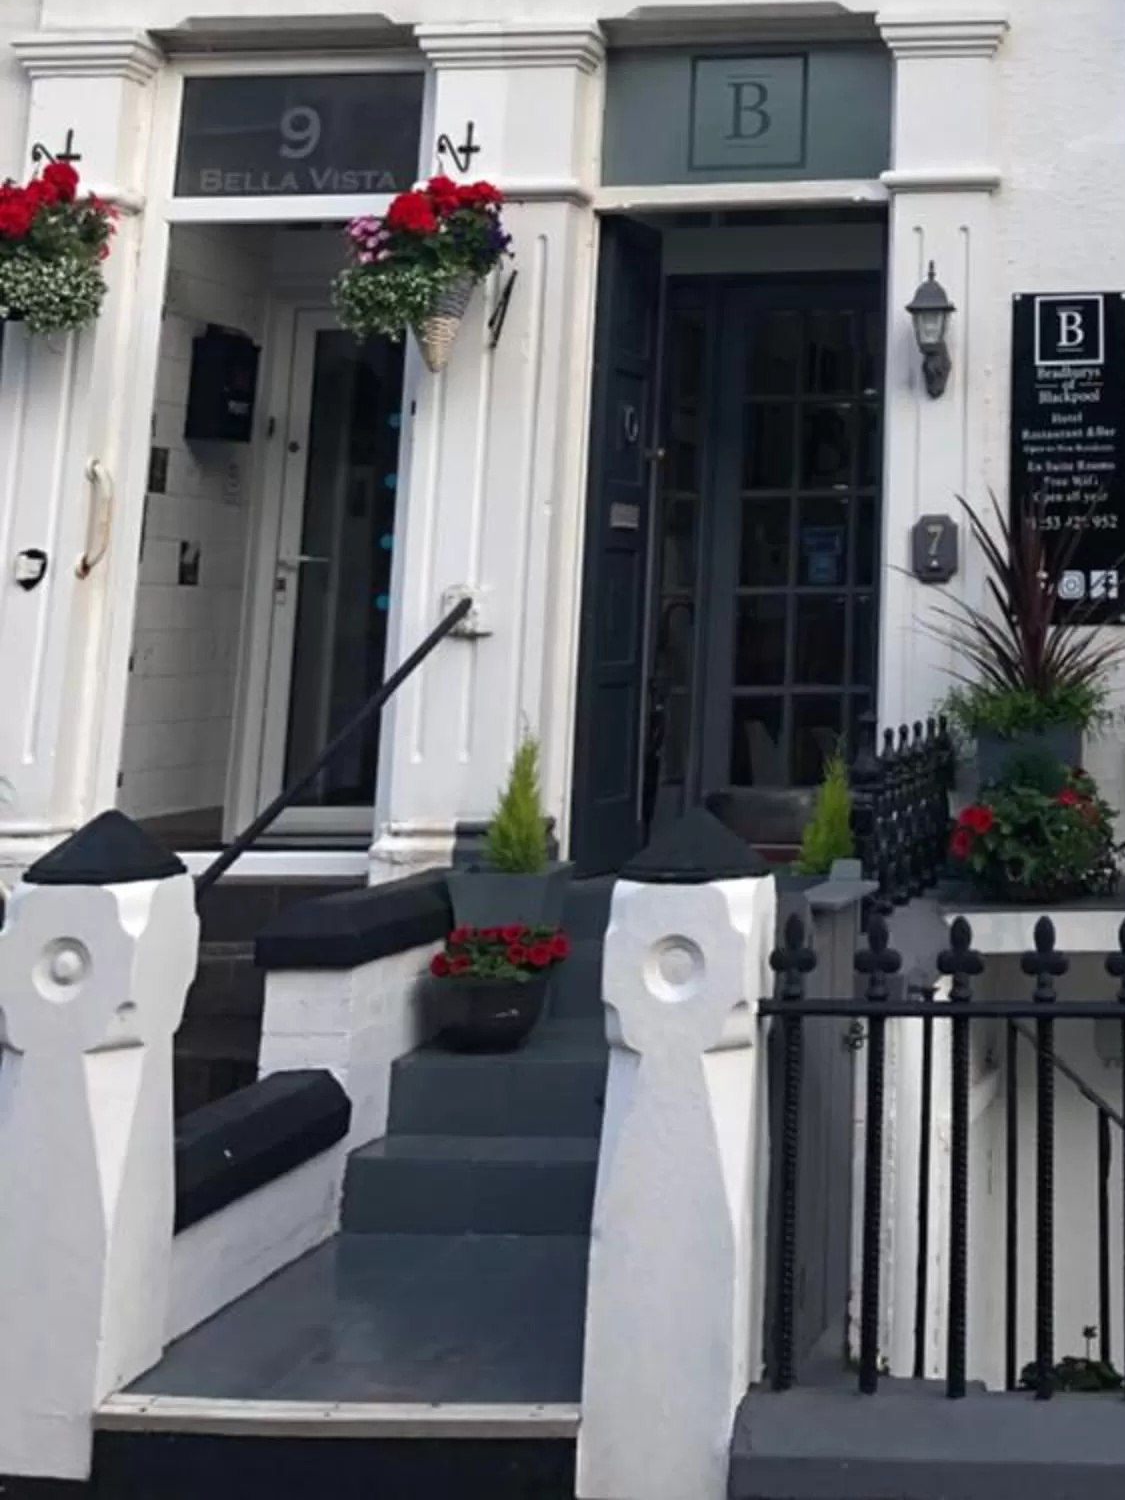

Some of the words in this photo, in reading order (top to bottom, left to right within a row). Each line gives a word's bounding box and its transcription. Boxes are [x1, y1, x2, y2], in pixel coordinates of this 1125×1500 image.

[724, 81, 772, 140] B
[279, 106, 321, 159] 9
[201, 167, 299, 192] BELLA
[309, 166, 396, 190] VISTA
[1057, 310, 1085, 348] B
[1037, 367, 1101, 381] Bradburys
[1038, 388, 1100, 404] Blackpool
[1051, 412, 1083, 424] Hotel
[926, 524, 944, 556] 7
